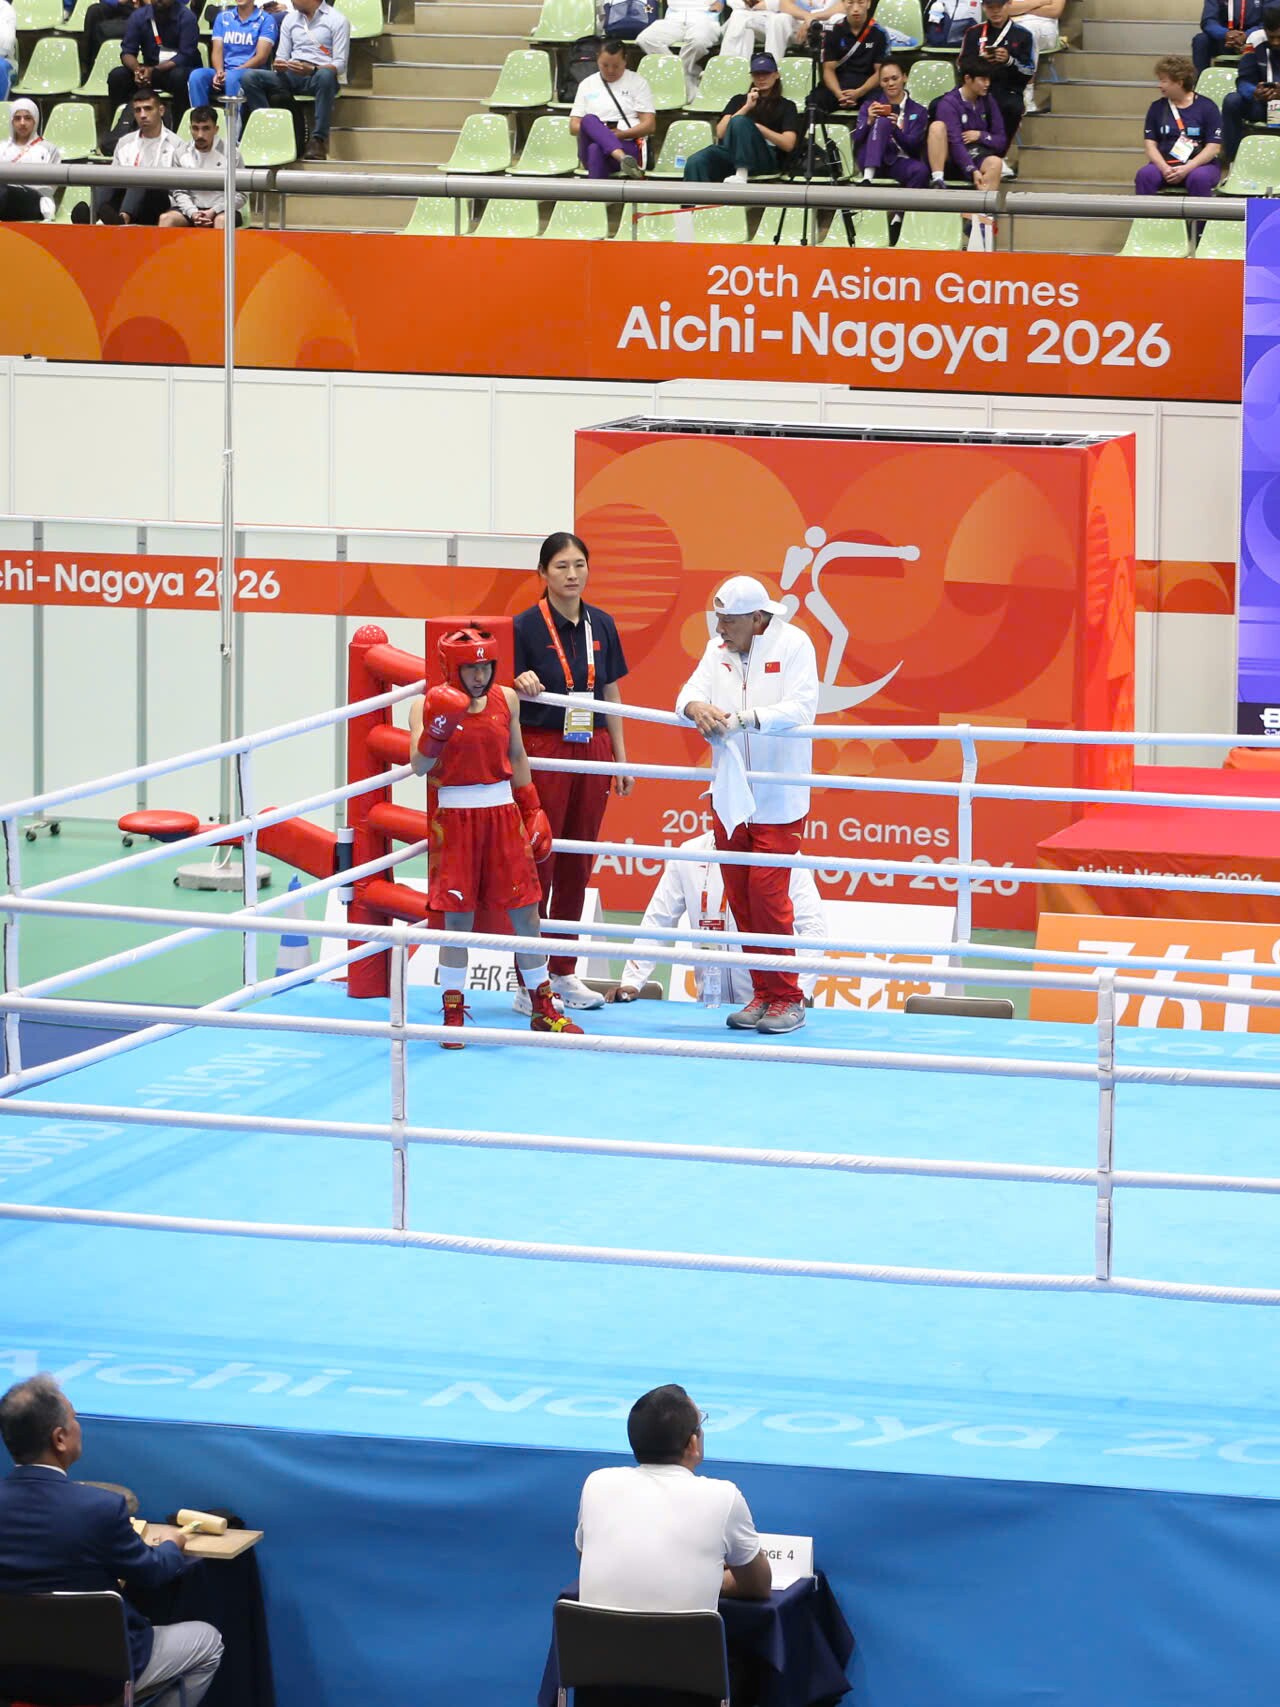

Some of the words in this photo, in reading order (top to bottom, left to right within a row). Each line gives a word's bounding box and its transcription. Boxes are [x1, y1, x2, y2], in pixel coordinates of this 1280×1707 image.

[224, 31, 254, 45] INDIA
[706, 264, 799, 298] 20th
[811, 268, 921, 302] Asian
[934, 272, 1080, 307] Games
[616, 302, 1008, 375] Aichi-Nagoya
[1026, 318, 1171, 368] 2026
[0, 560, 184, 604] hi-Nagoya
[661, 810, 713, 834] 20t
[838, 817, 951, 847] Games
[786, 1550, 795, 1561] 4
